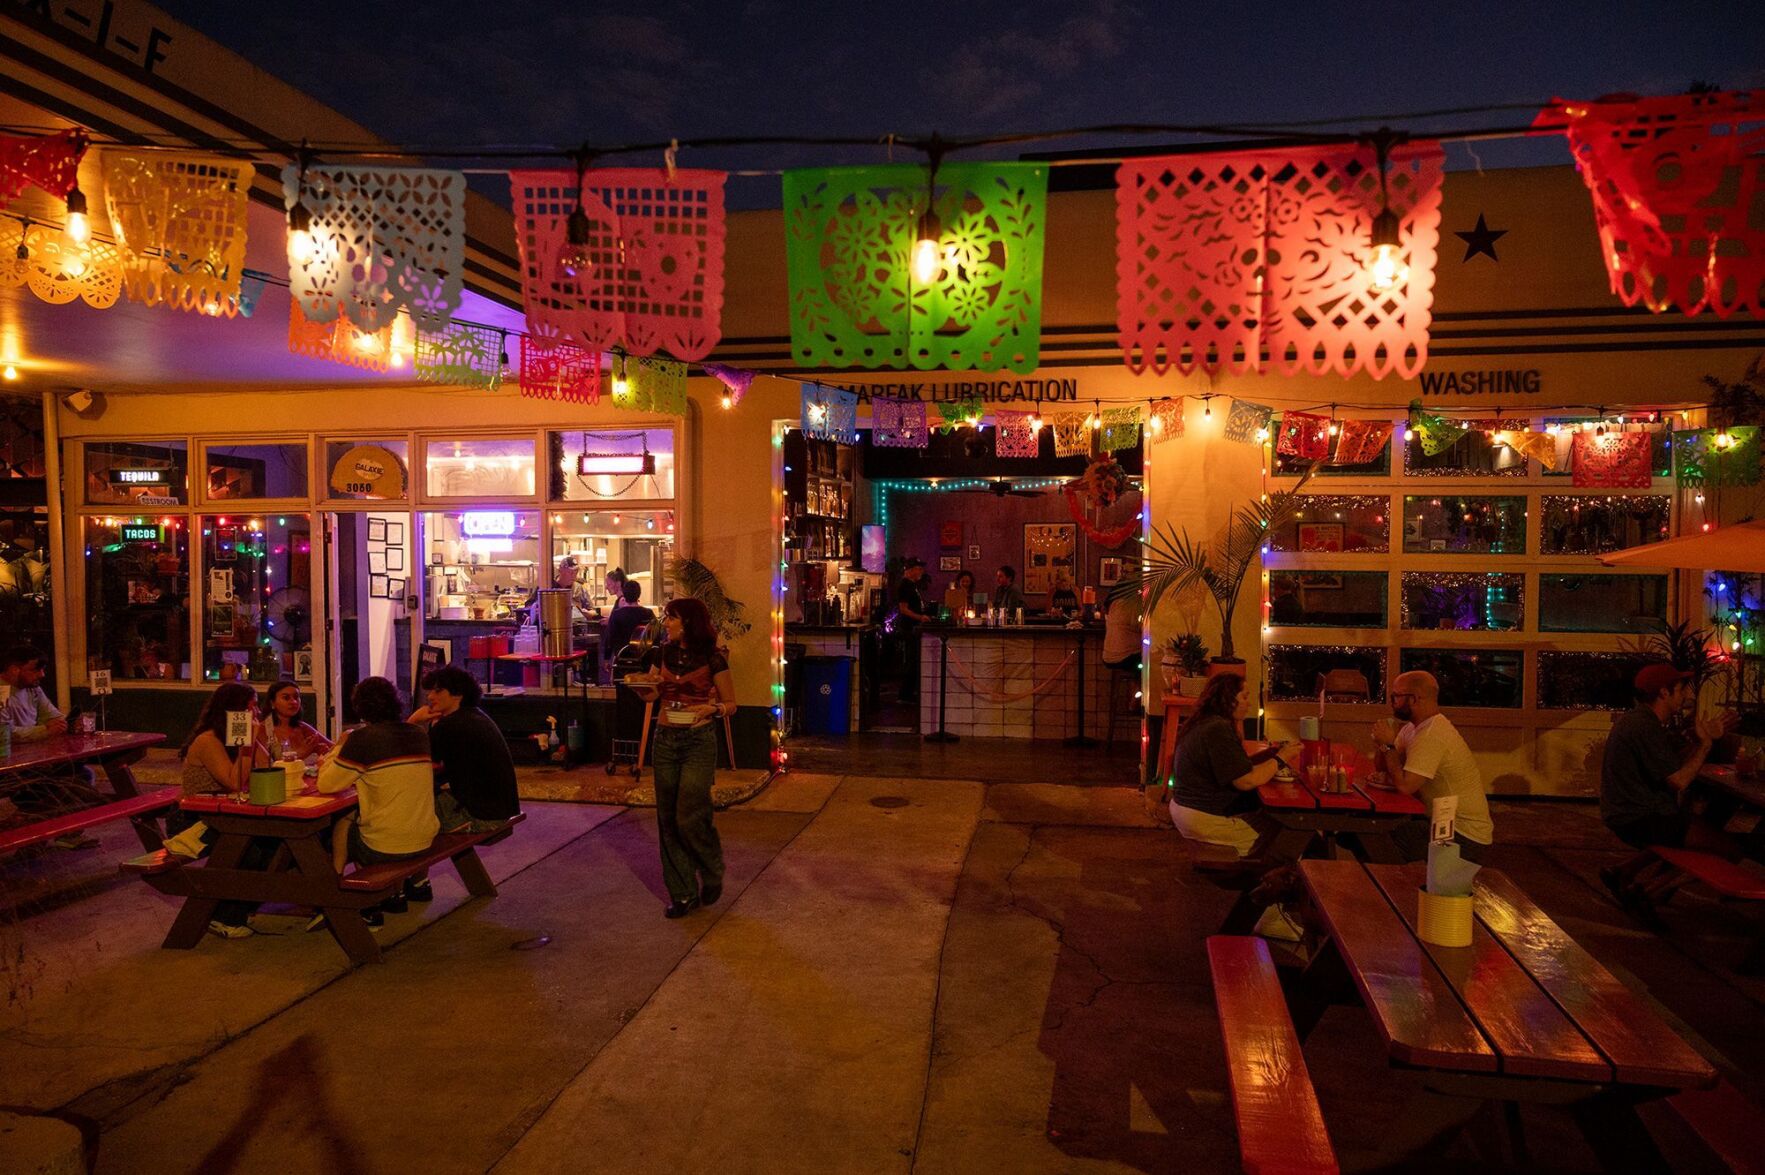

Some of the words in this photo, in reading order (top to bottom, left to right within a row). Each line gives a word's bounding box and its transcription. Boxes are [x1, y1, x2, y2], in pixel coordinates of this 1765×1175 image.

[932, 379, 1077, 403] LUBRICATION
[1419, 369, 1540, 395] WASHING
[119, 471, 160, 483] TEQUILA
[124, 528, 156, 539] TACOS
